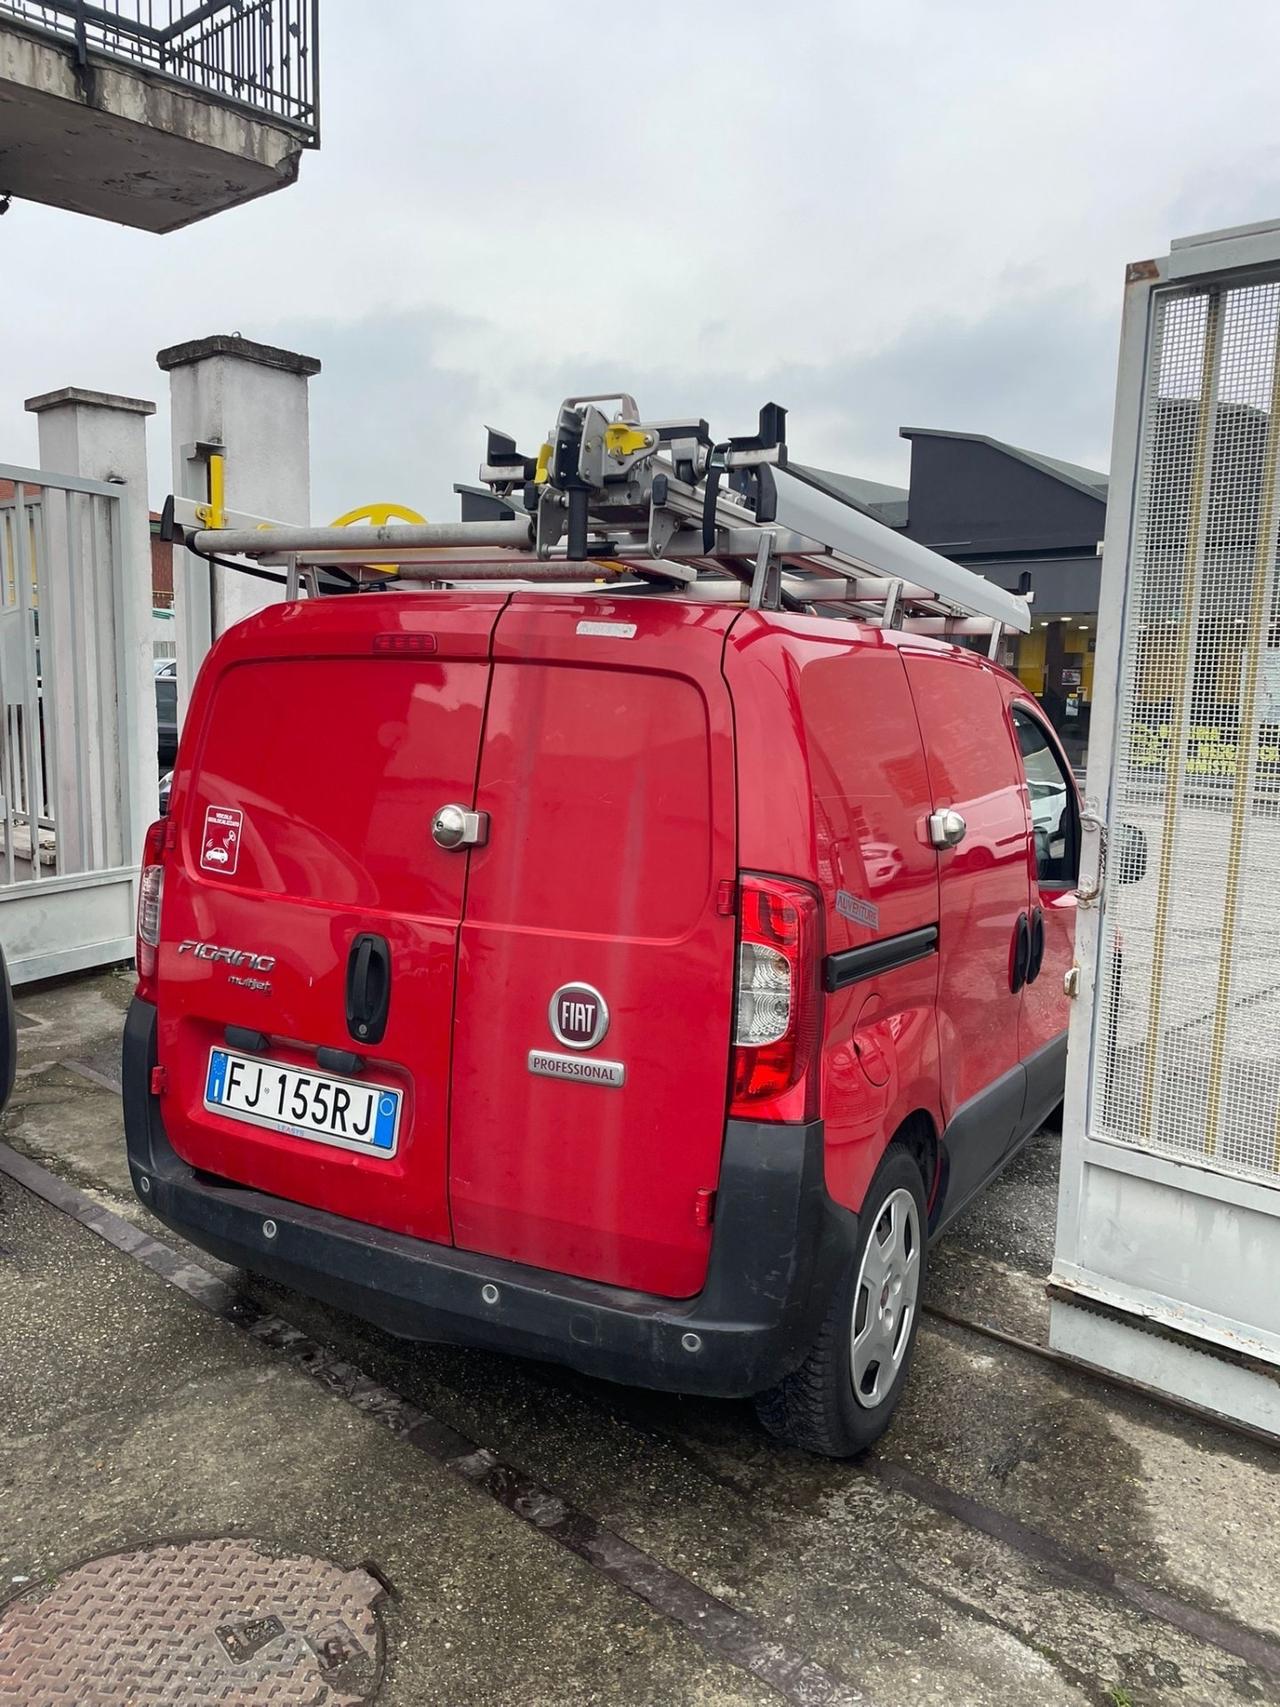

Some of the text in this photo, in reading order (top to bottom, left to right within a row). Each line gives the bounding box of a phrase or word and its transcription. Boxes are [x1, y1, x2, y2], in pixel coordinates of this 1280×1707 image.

[178, 940, 276, 972] FIORINO
[562, 1001, 596, 1033] FIAT
[533, 1057, 615, 1081] PROFESSIONAL
[226, 1061, 374, 1136] FJ 155RJ
